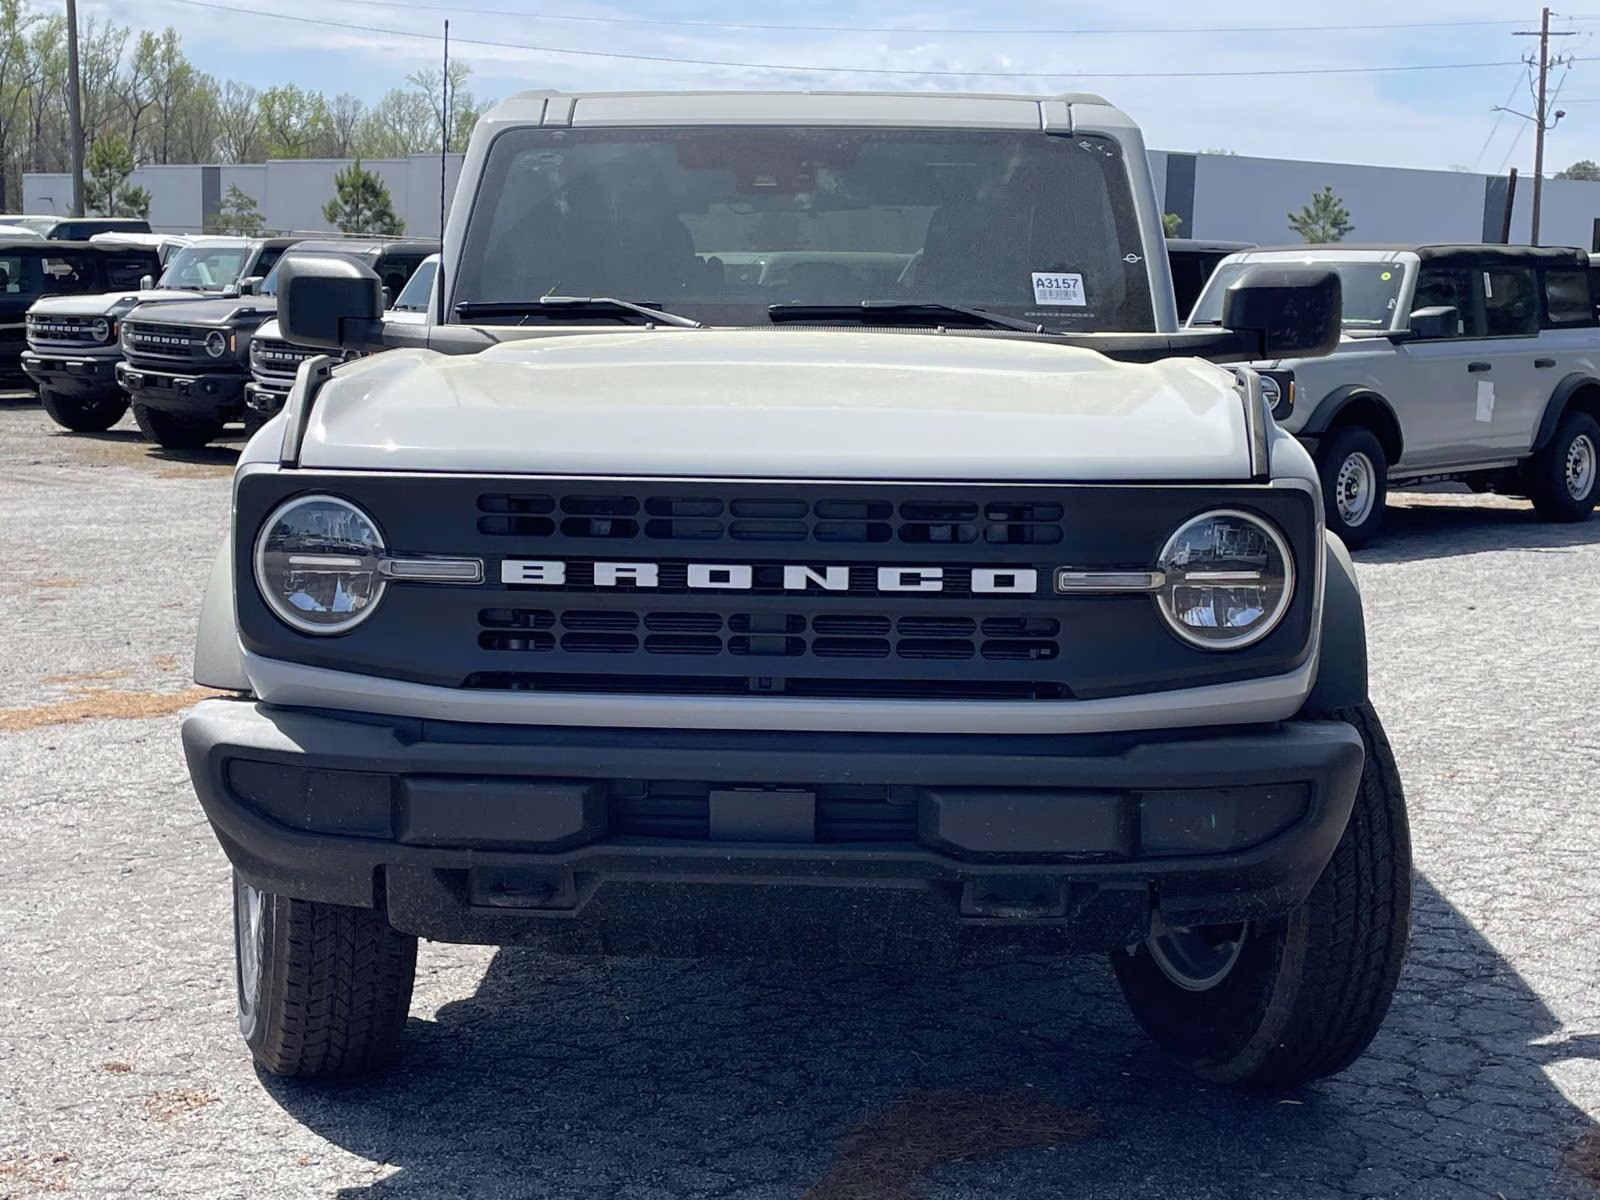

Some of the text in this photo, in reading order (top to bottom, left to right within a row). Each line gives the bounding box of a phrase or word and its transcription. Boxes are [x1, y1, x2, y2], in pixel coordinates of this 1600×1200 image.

[1036, 278, 1079, 289] A3157
[135, 334, 190, 345] BRONCO
[501, 560, 1037, 593] BRONCO
